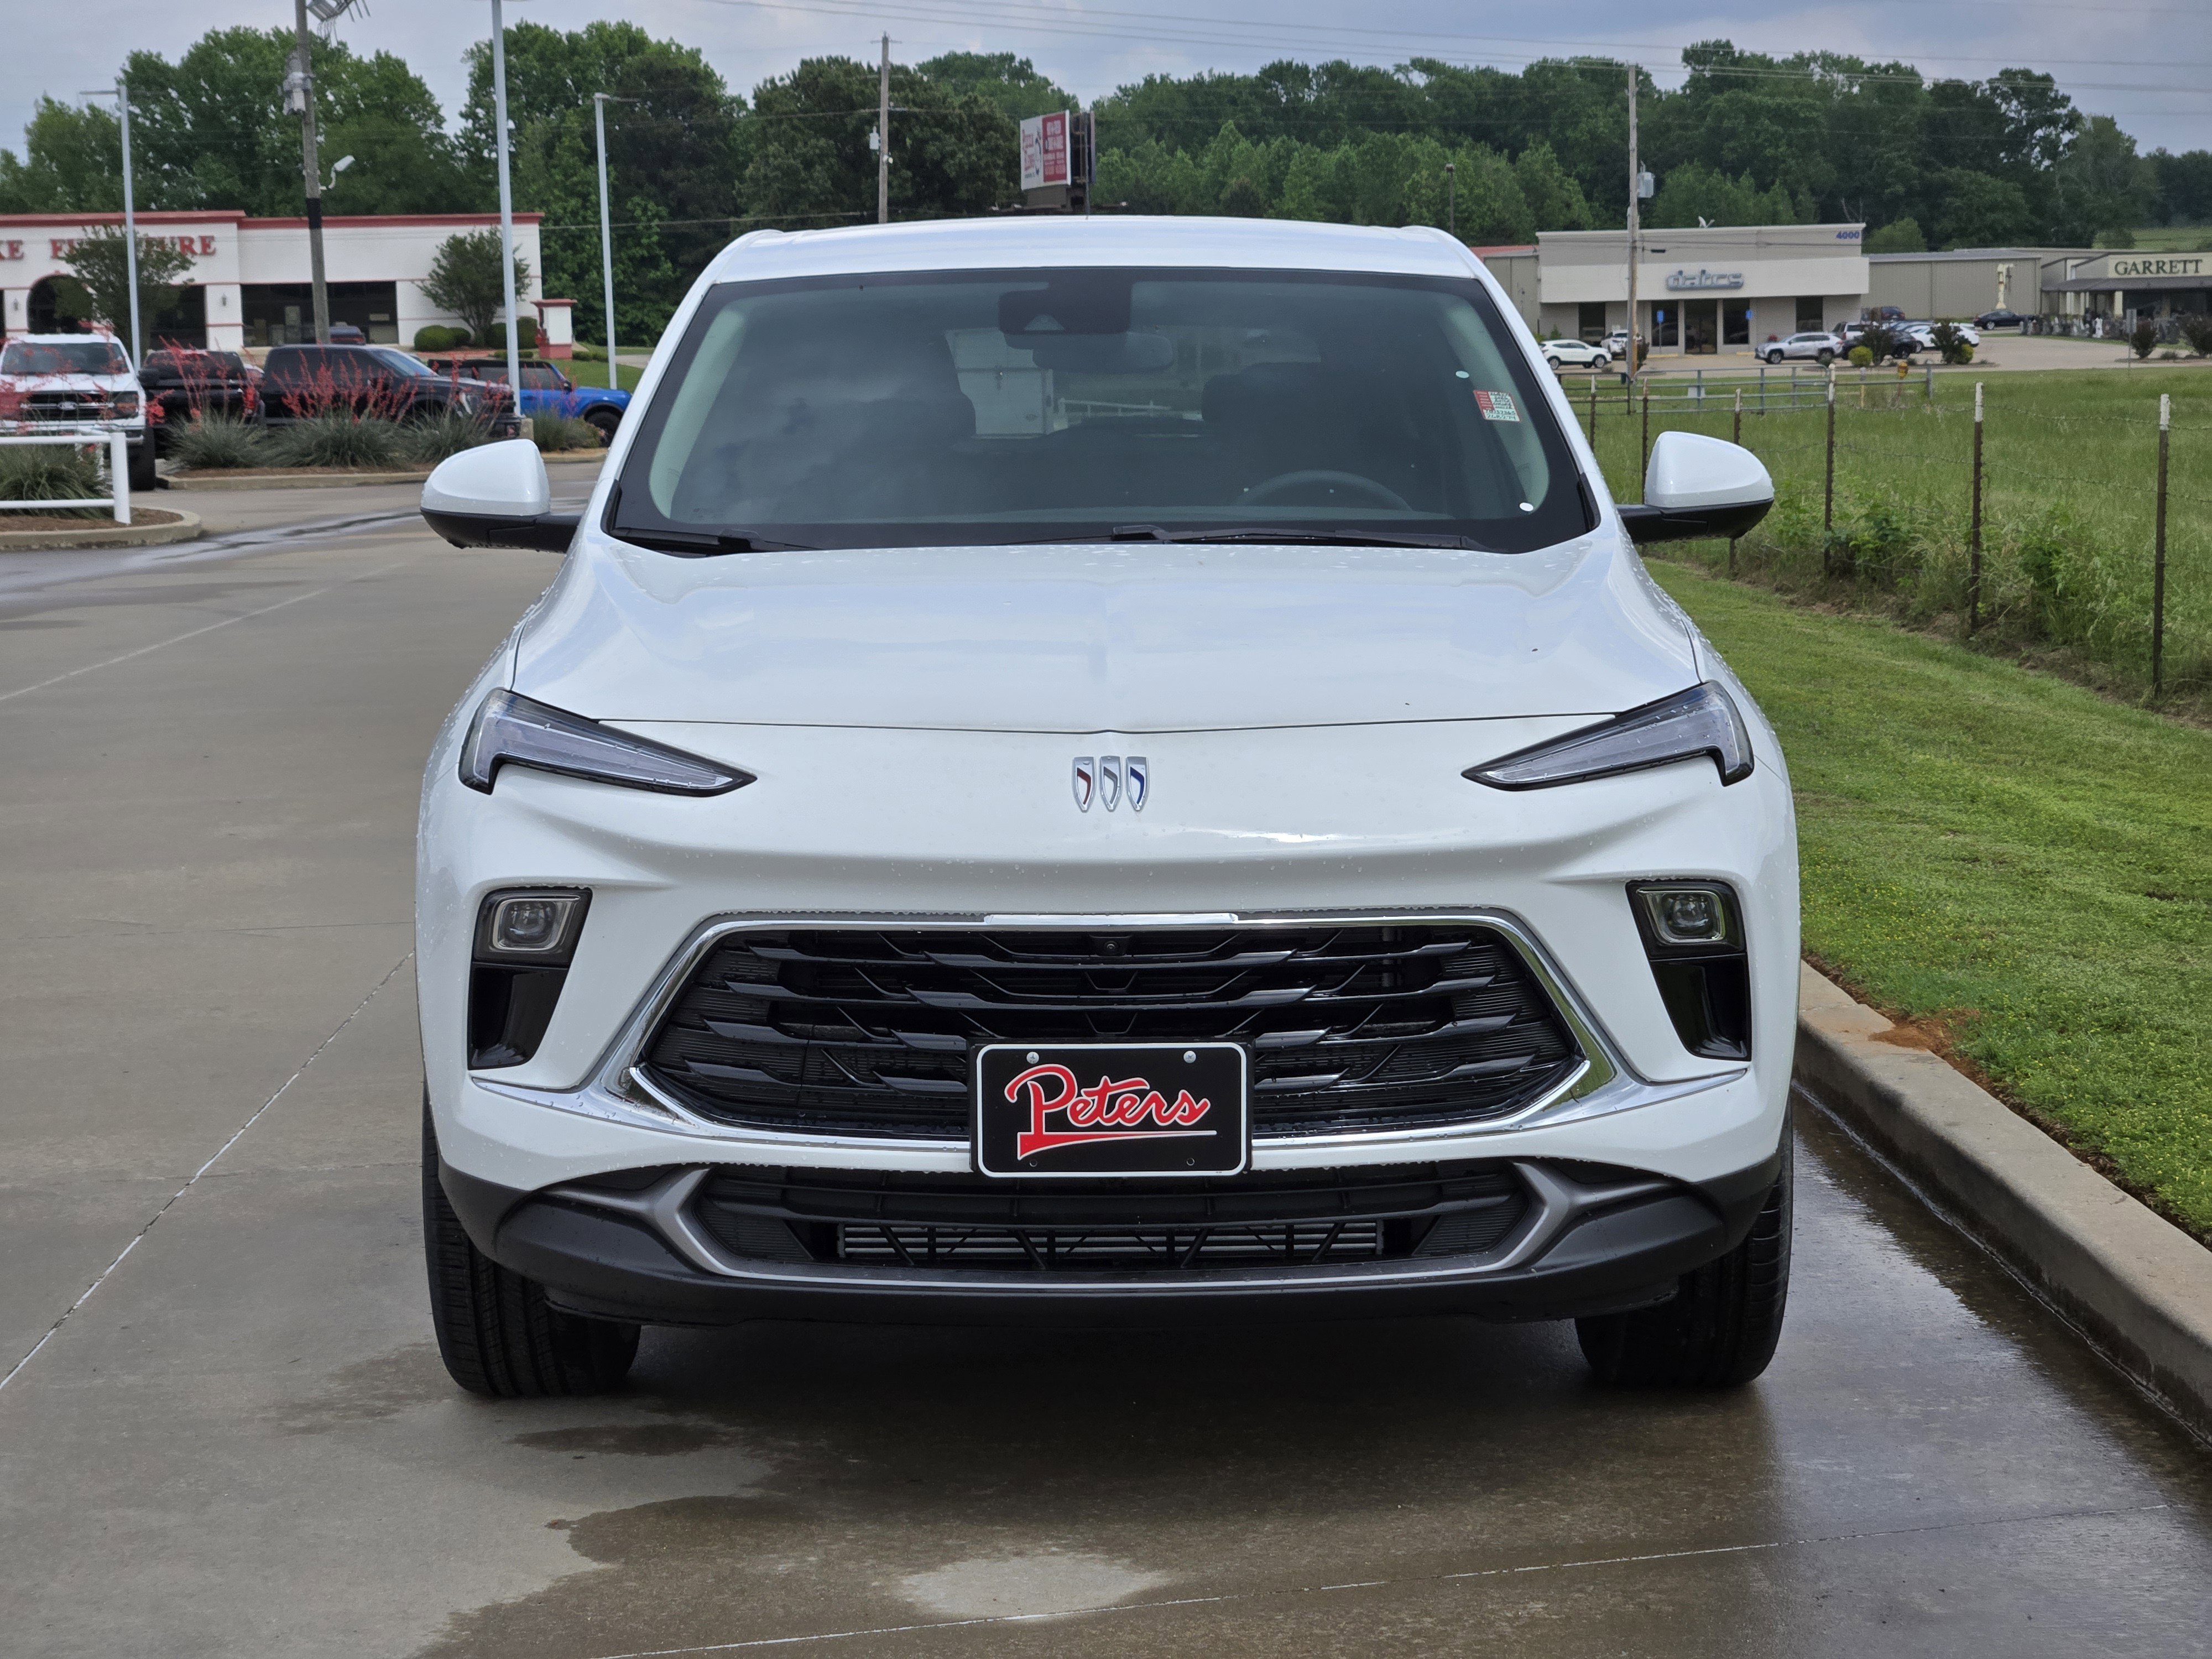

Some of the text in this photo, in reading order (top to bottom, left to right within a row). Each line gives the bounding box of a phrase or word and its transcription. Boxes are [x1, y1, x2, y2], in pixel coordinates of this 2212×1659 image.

[1836, 230, 1860, 239] 4000
[2114, 259, 2203, 275] GARRETT
[1004, 1063, 1212, 1137] Peters
